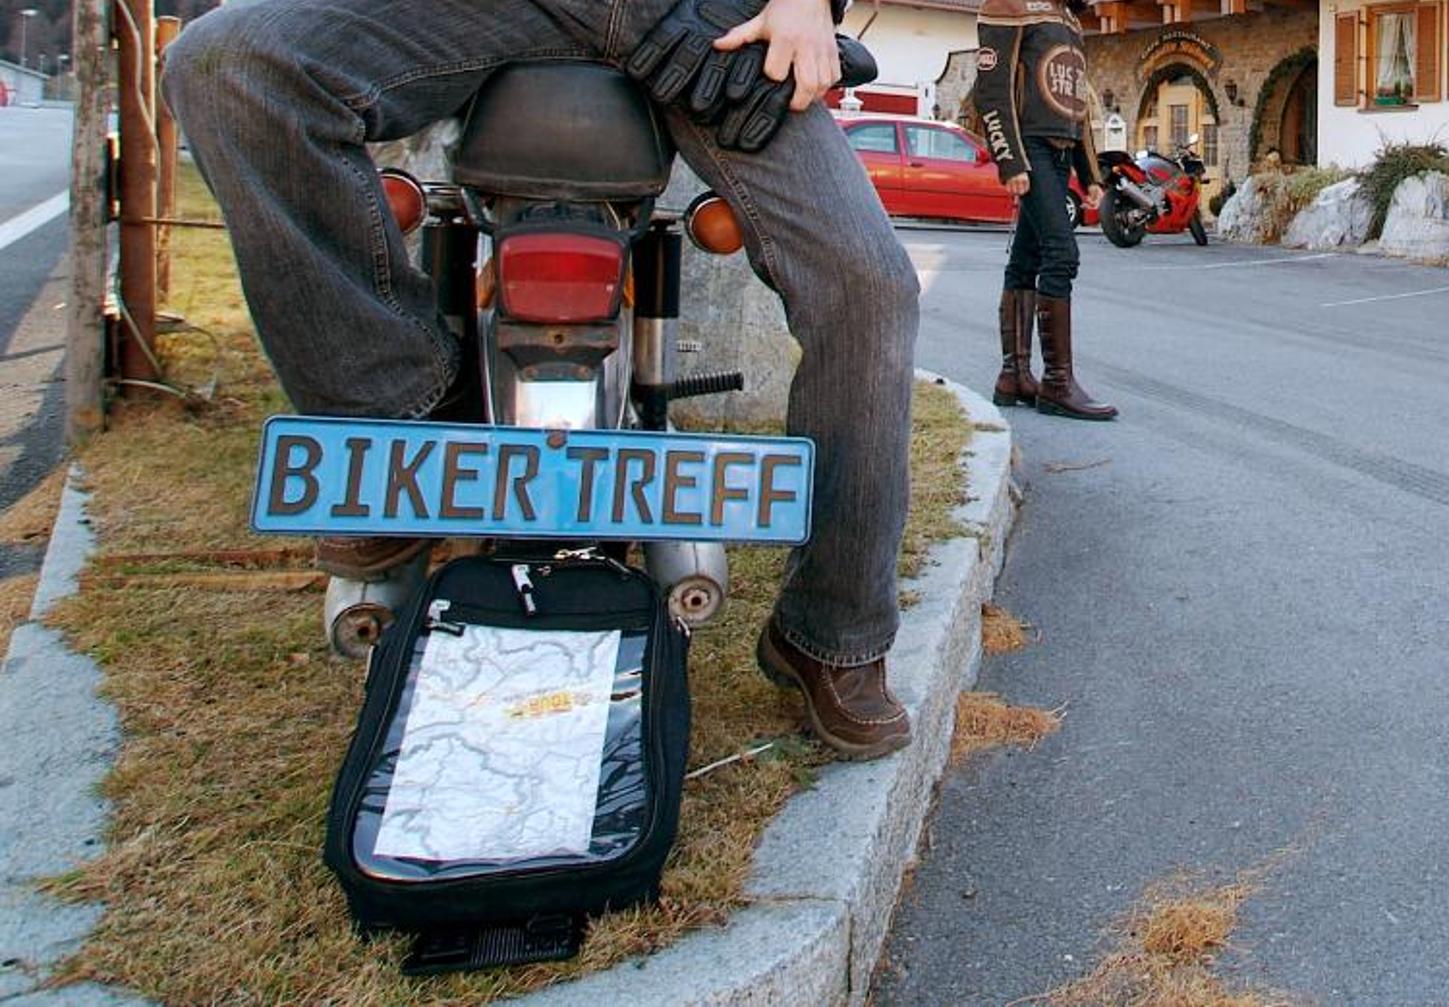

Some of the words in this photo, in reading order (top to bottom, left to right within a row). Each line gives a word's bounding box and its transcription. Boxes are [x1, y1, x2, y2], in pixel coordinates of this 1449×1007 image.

[982, 109, 1015, 162] LUCKY
[266, 433, 541, 522] BIKER
[566, 445, 804, 529] TREFF
